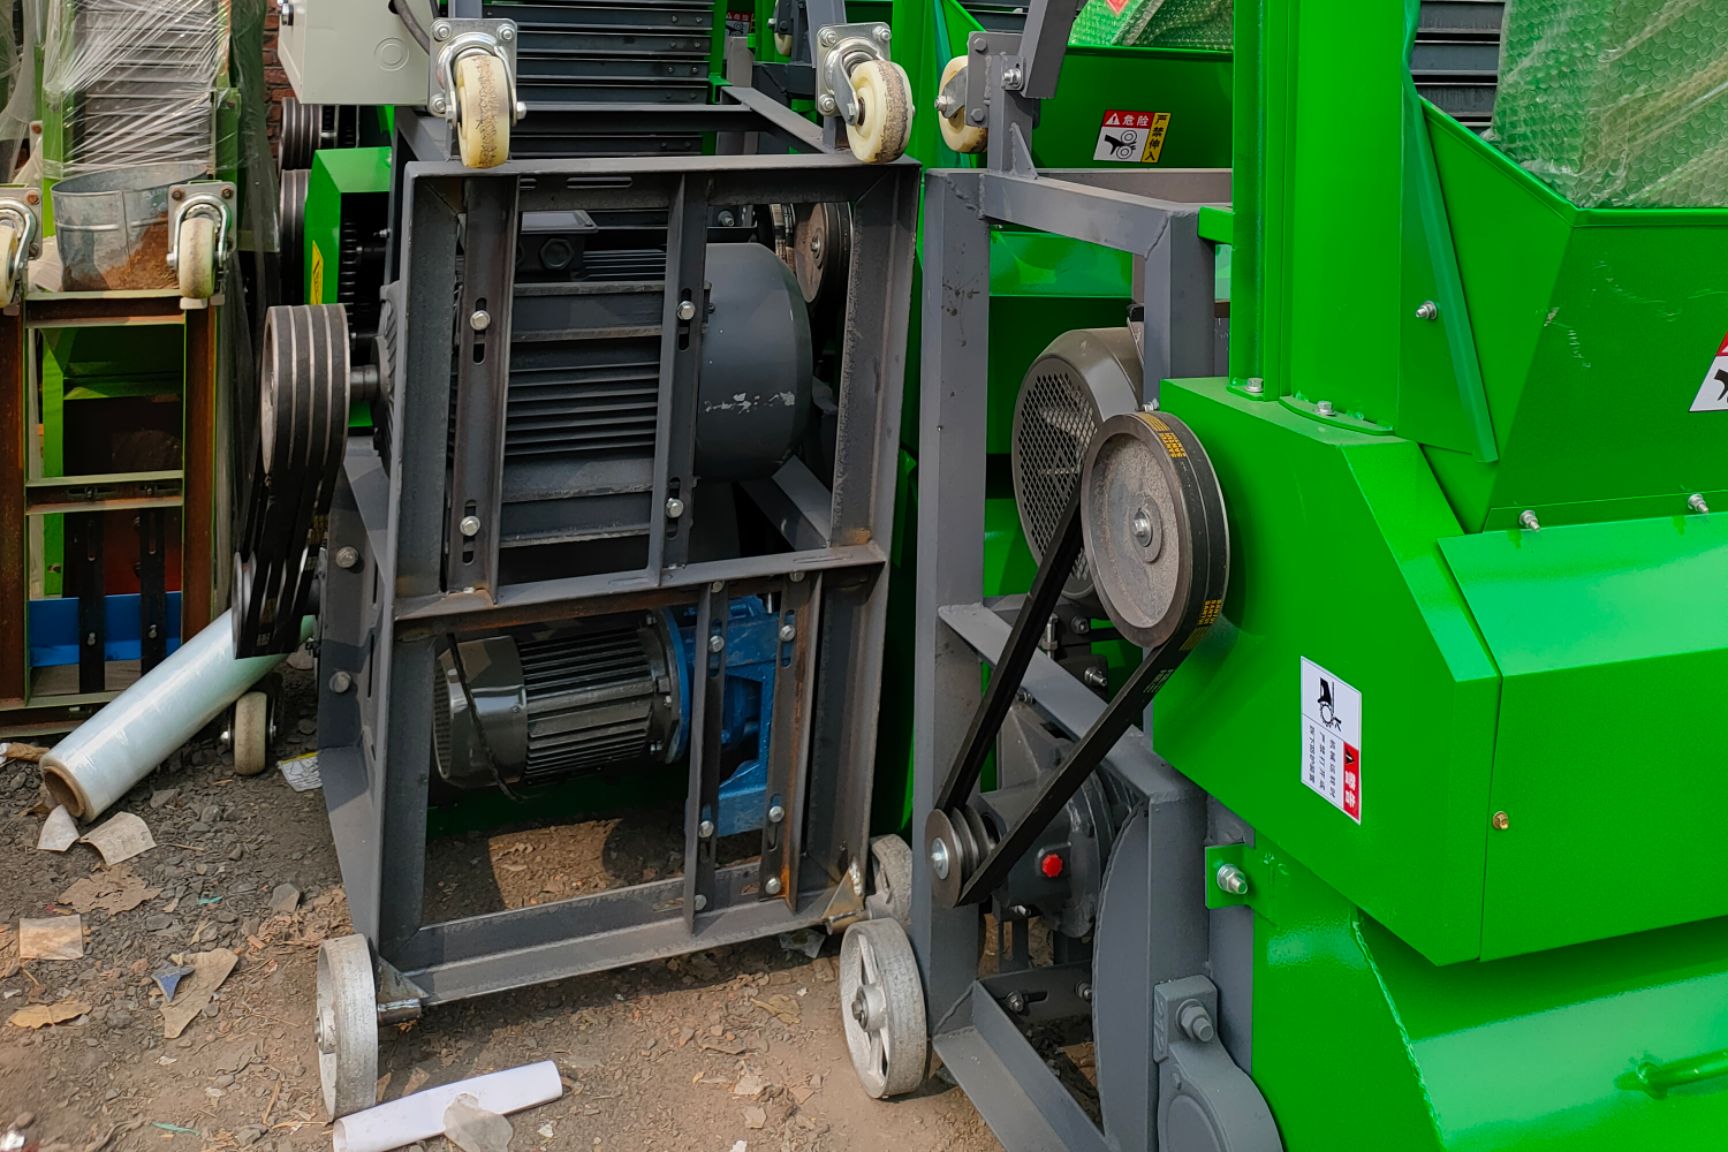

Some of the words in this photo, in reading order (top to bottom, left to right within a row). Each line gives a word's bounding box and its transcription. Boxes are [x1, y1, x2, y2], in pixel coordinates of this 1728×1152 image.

[1122, 114, 1149, 127] 危险
[1144, 114, 1168, 161] 严禁伸入
[1345, 770, 1356, 809] 警告
